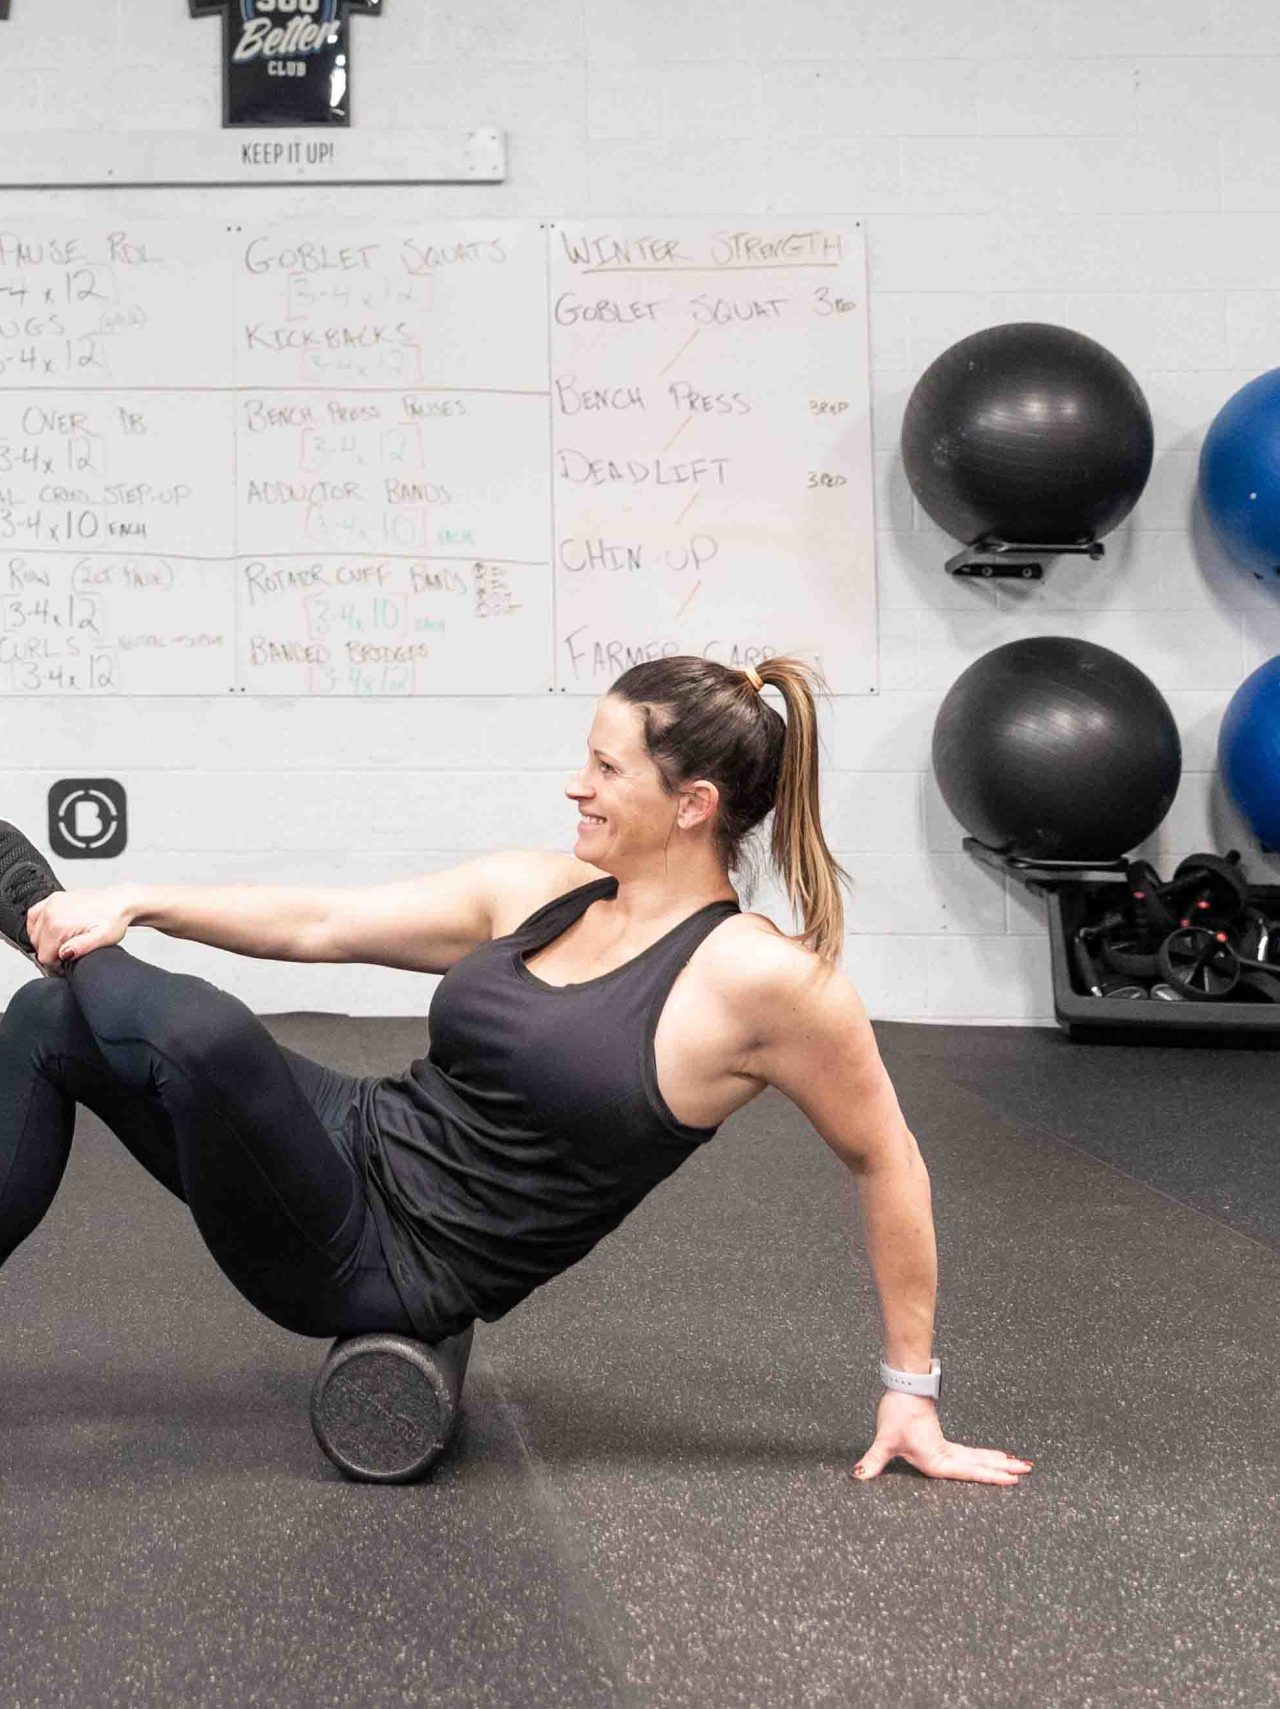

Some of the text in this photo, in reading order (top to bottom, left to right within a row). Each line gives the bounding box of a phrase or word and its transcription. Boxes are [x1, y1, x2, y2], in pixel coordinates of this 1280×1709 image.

[232, 15, 341, 60] Better
[267, 60, 307, 77] CLUB
[241, 141, 334, 165] KEEP IT UP!
[244, 237, 382, 274] GOBLET
[561, 229, 842, 266] WINTER STRENGTH
[555, 292, 663, 327] GOBLET
[690, 293, 789, 325] SQUAT
[555, 374, 646, 416] BENCH
[668, 380, 752, 416] PRESS
[558, 448, 731, 486] DEADLIFT
[559, 538, 642, 573] CHIN
